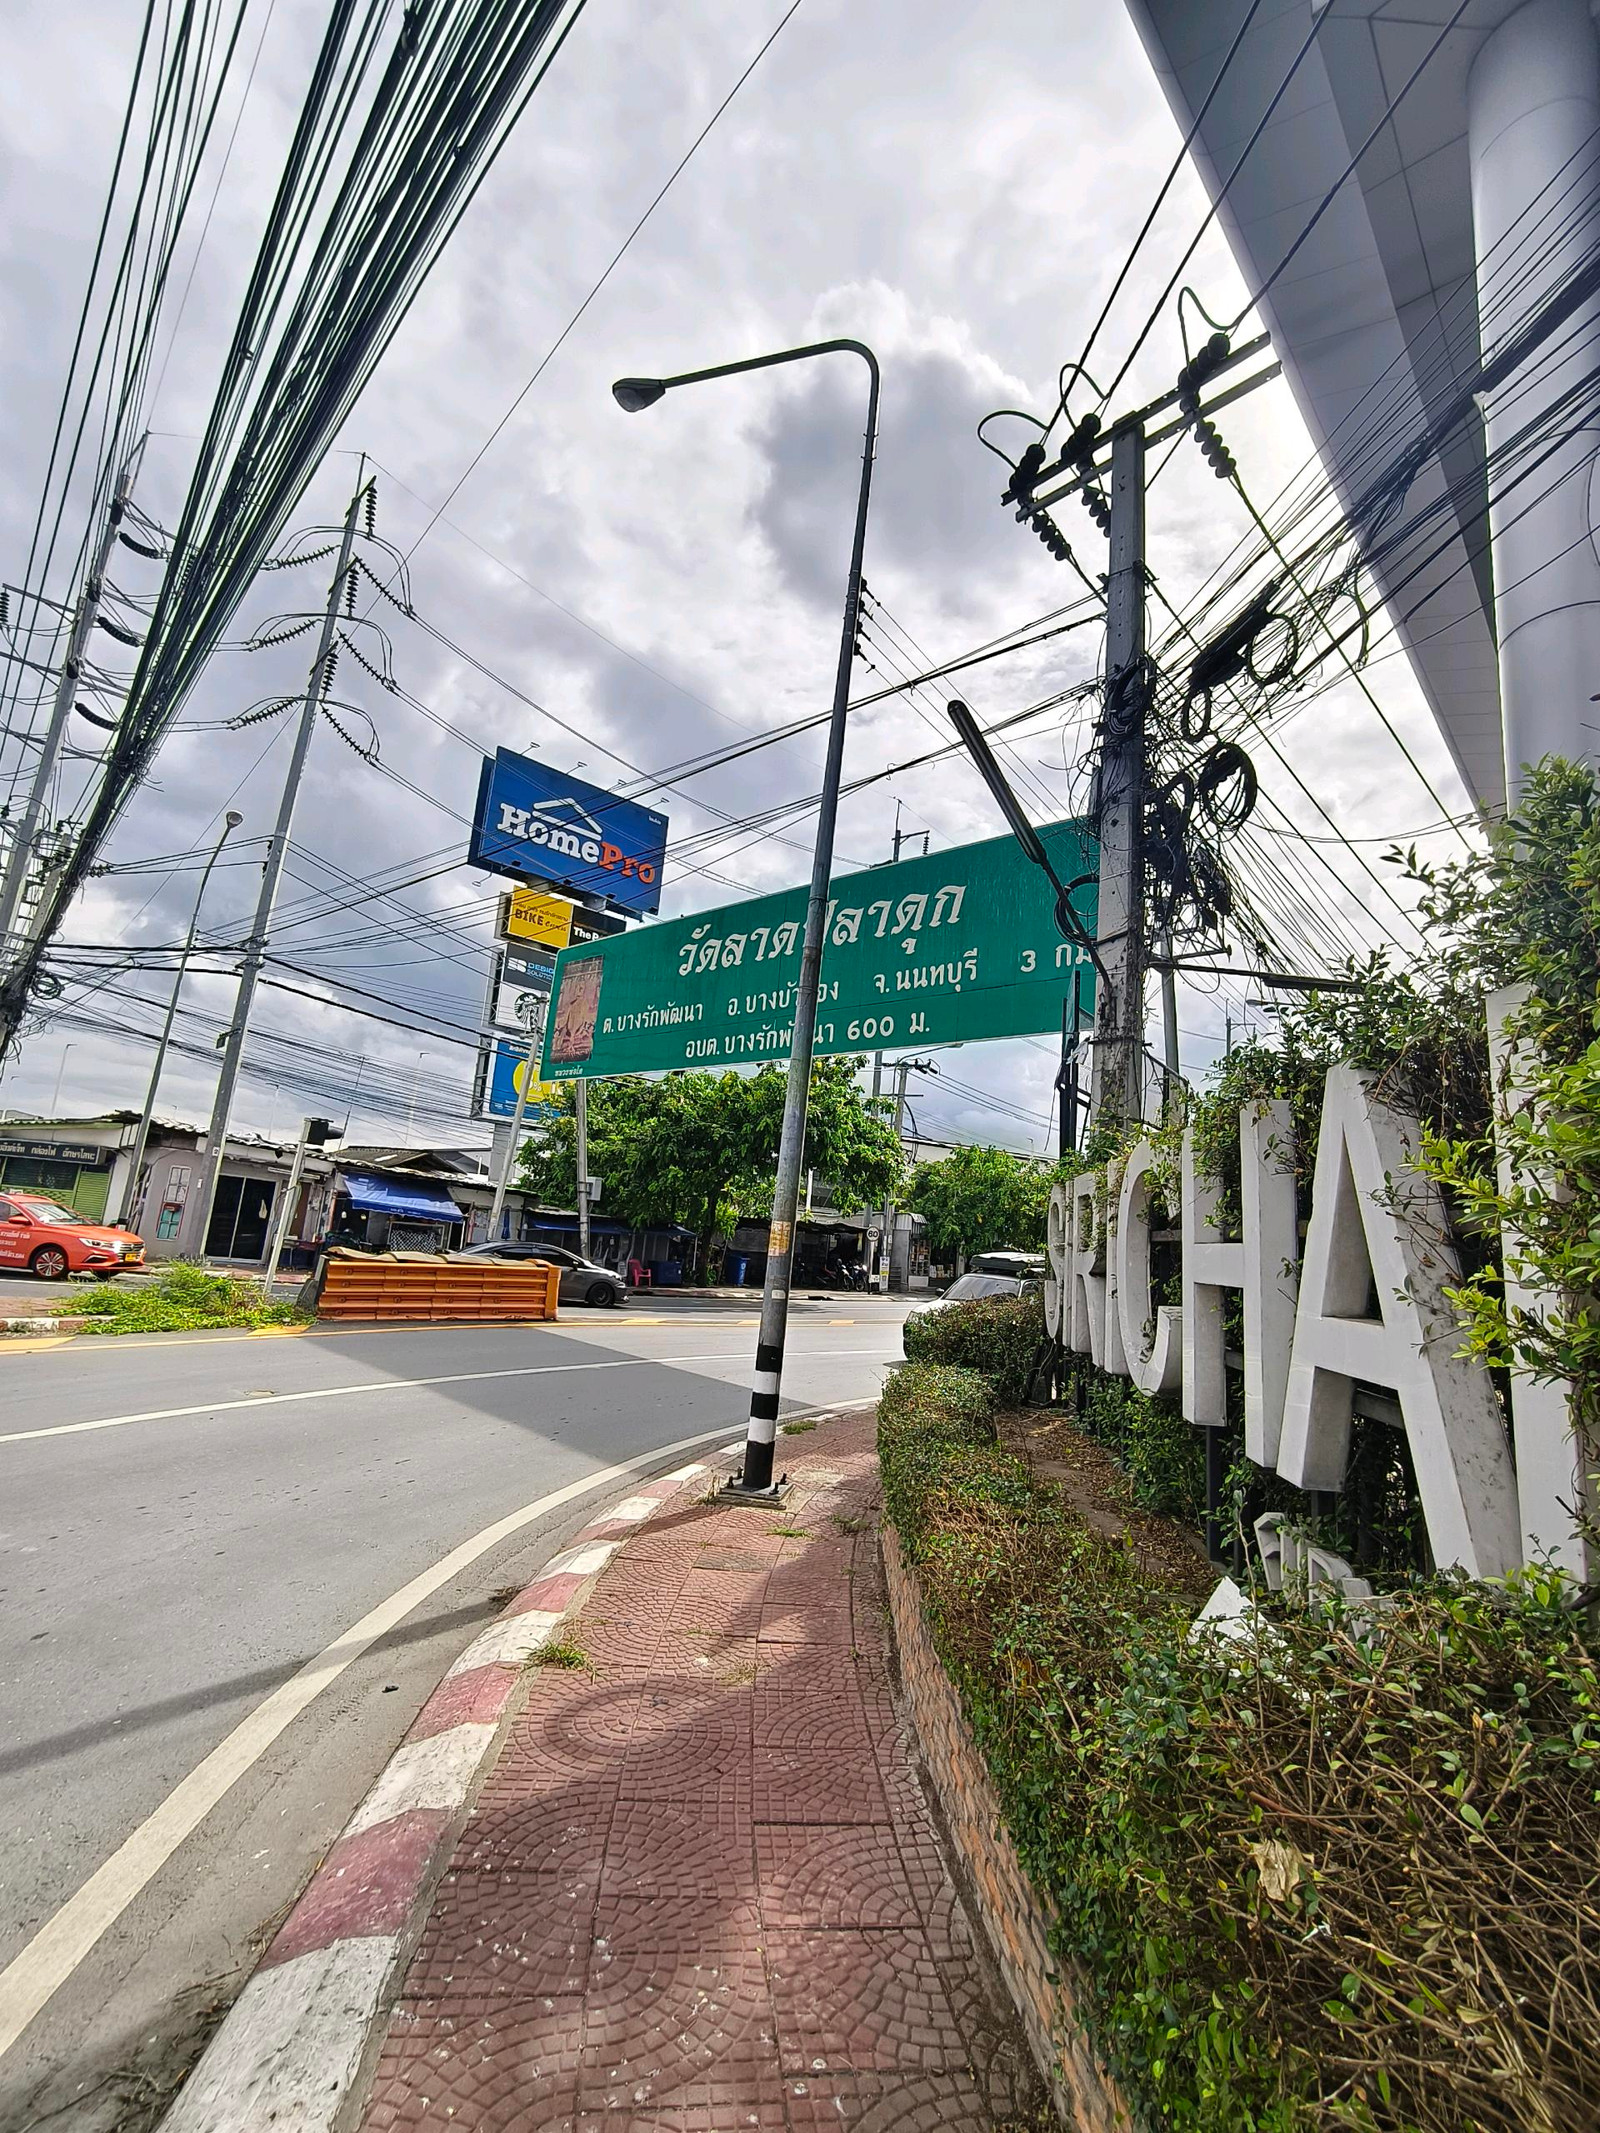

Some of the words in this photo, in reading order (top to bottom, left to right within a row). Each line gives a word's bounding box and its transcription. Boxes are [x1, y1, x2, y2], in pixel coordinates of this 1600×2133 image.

[497, 802, 655, 884] HomePro
[514, 908, 545, 926] BIKE
[573, 927, 591, 940] The
[1020, 950, 1037, 972] 3
[846, 1016, 895, 1040] 600
[909, 1012, 930, 1034] ม.
